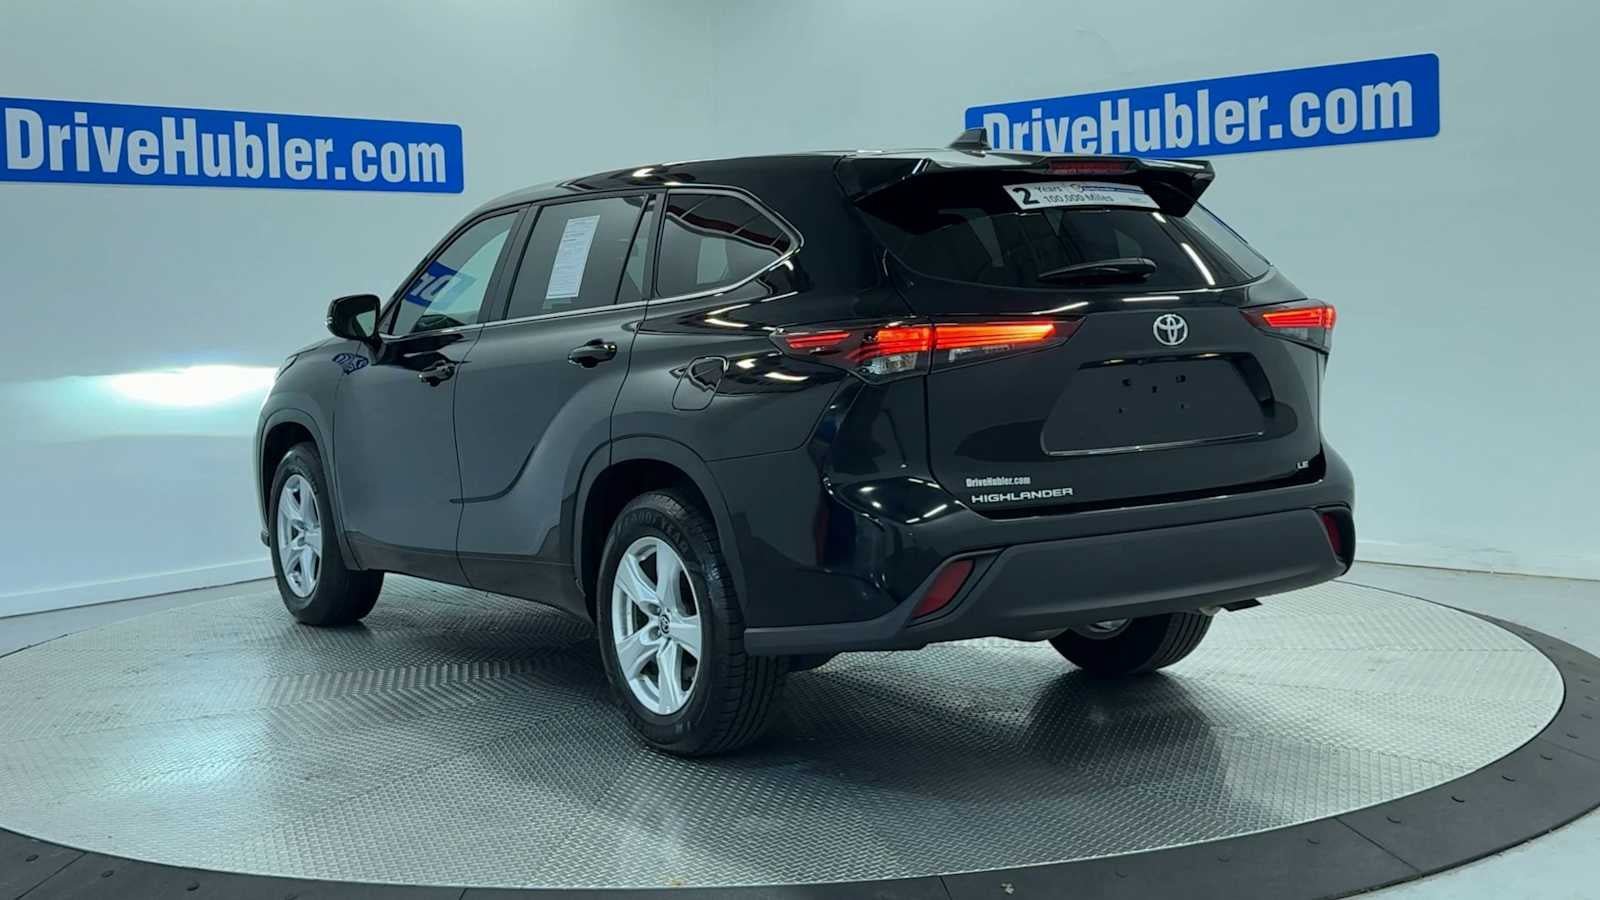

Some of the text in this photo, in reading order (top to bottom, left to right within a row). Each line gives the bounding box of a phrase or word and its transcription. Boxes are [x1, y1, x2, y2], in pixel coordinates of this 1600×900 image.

[983, 80, 1413, 154] DriveHubler.com
[5, 107, 446, 183] DriveHubler.com
[1012, 187, 1041, 205] 2
[1297, 460, 1309, 469] LE
[966, 476, 1031, 488] DriveHubler.com
[971, 487, 1074, 503] HIGHLANDER
